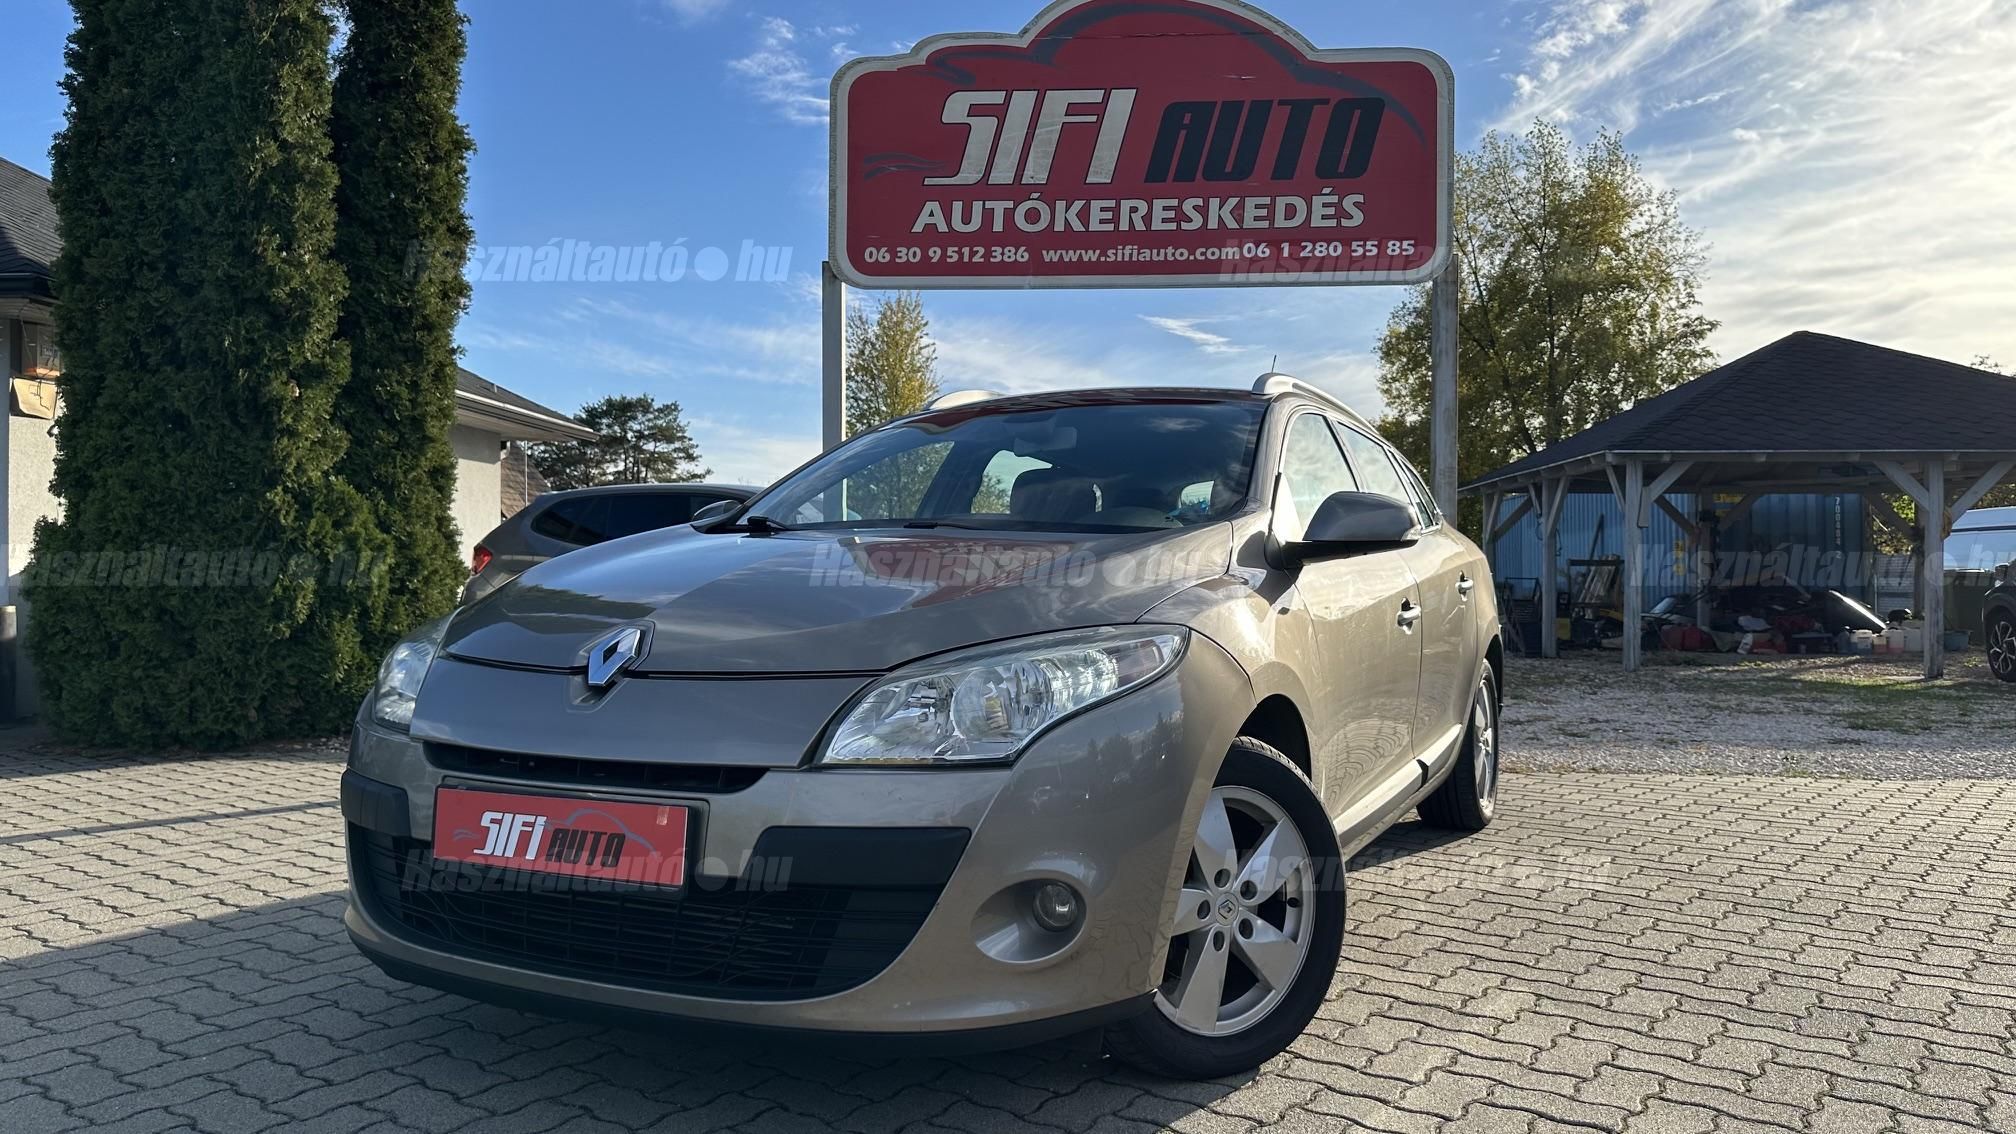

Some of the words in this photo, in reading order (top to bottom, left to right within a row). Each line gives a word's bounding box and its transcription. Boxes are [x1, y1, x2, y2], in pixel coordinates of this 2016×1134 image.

[922, 88, 1138, 186] SIFI
[1144, 97, 1386, 183] AUTO
[910, 188, 1366, 234] AUTÓKERESKEDÉS
[864, 247, 891, 263] 06
[895, 246, 922, 263] 30
[990, 246, 1030, 263] 386
[1041, 244, 1241, 263] www.sifiauto.com
[1242, 242, 1271, 258] 06
[1281, 242, 1291, 257] 1
[1299, 241, 1343, 257] 280
[1350, 240, 1379, 256] 55
[1386, 239, 1416, 255] 85
[472, 810, 548, 861] SIFI
[544, 828, 627, 868] AUTO
